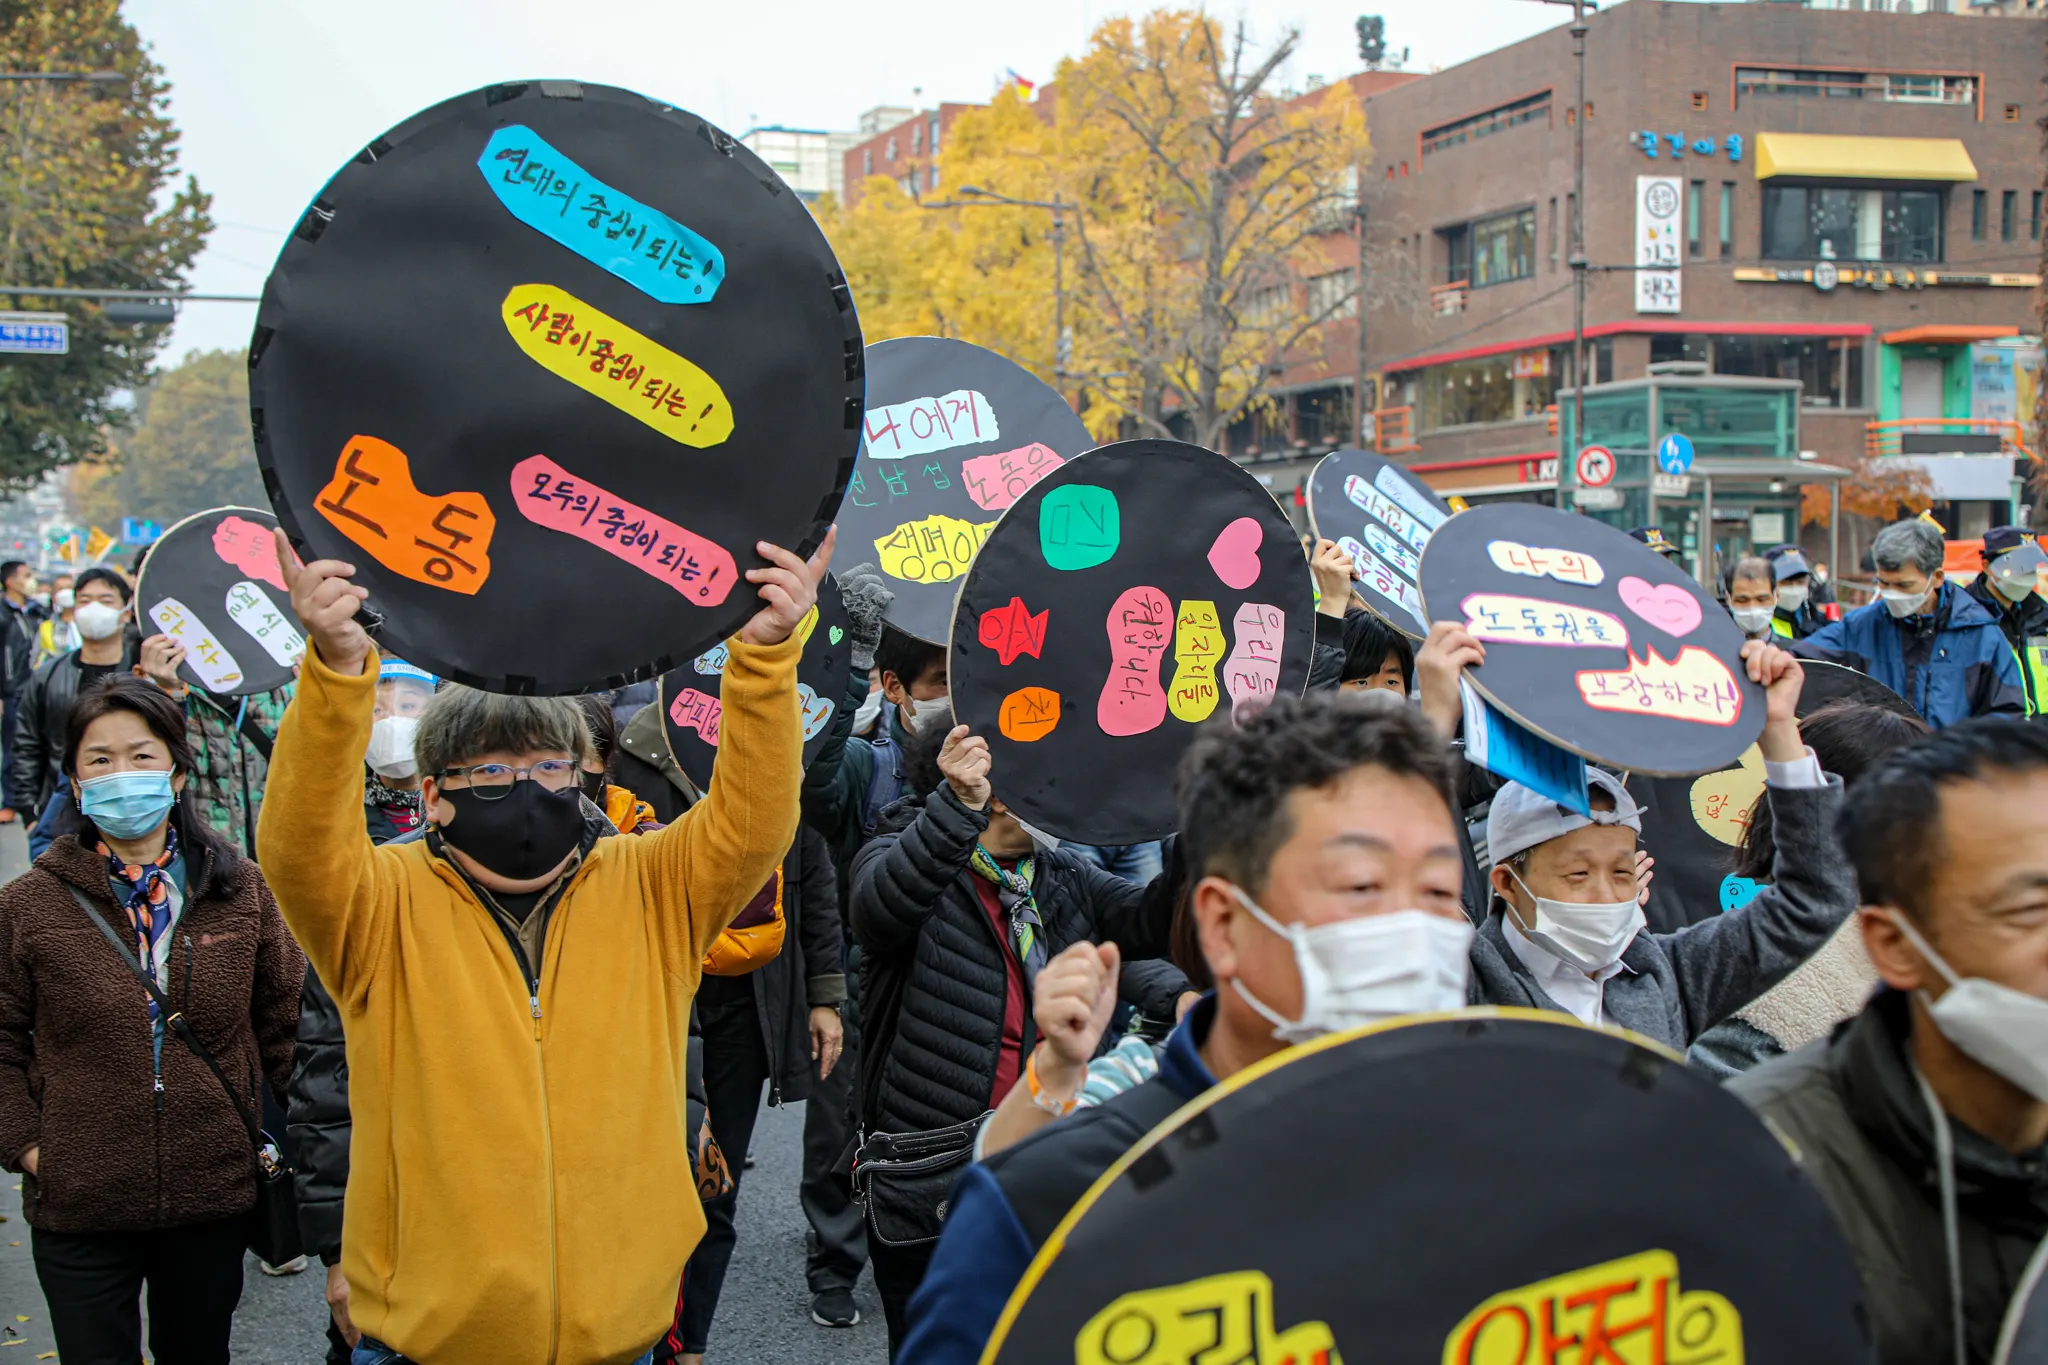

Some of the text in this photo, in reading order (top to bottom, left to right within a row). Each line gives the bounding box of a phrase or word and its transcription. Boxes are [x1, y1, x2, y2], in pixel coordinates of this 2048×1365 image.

[494, 147, 714, 295] 연대의 중심이 되는!
[513, 301, 592, 356] 사람이
[590, 339, 645, 390] 중심이
[319, 449, 480, 582] 노동
[528, 473, 720, 597] 모두의 중심이 되는!
[1049, 500, 1113, 547] 김
[1509, 549, 1587, 581] 나의
[159, 604, 242, 686] 하자!
[1176, 612, 1217, 708] 일자리를
[1479, 605, 1612, 643] 노동권을
[1008, 692, 1055, 733] 천
[1591, 672, 1737, 714] 보장하라!
